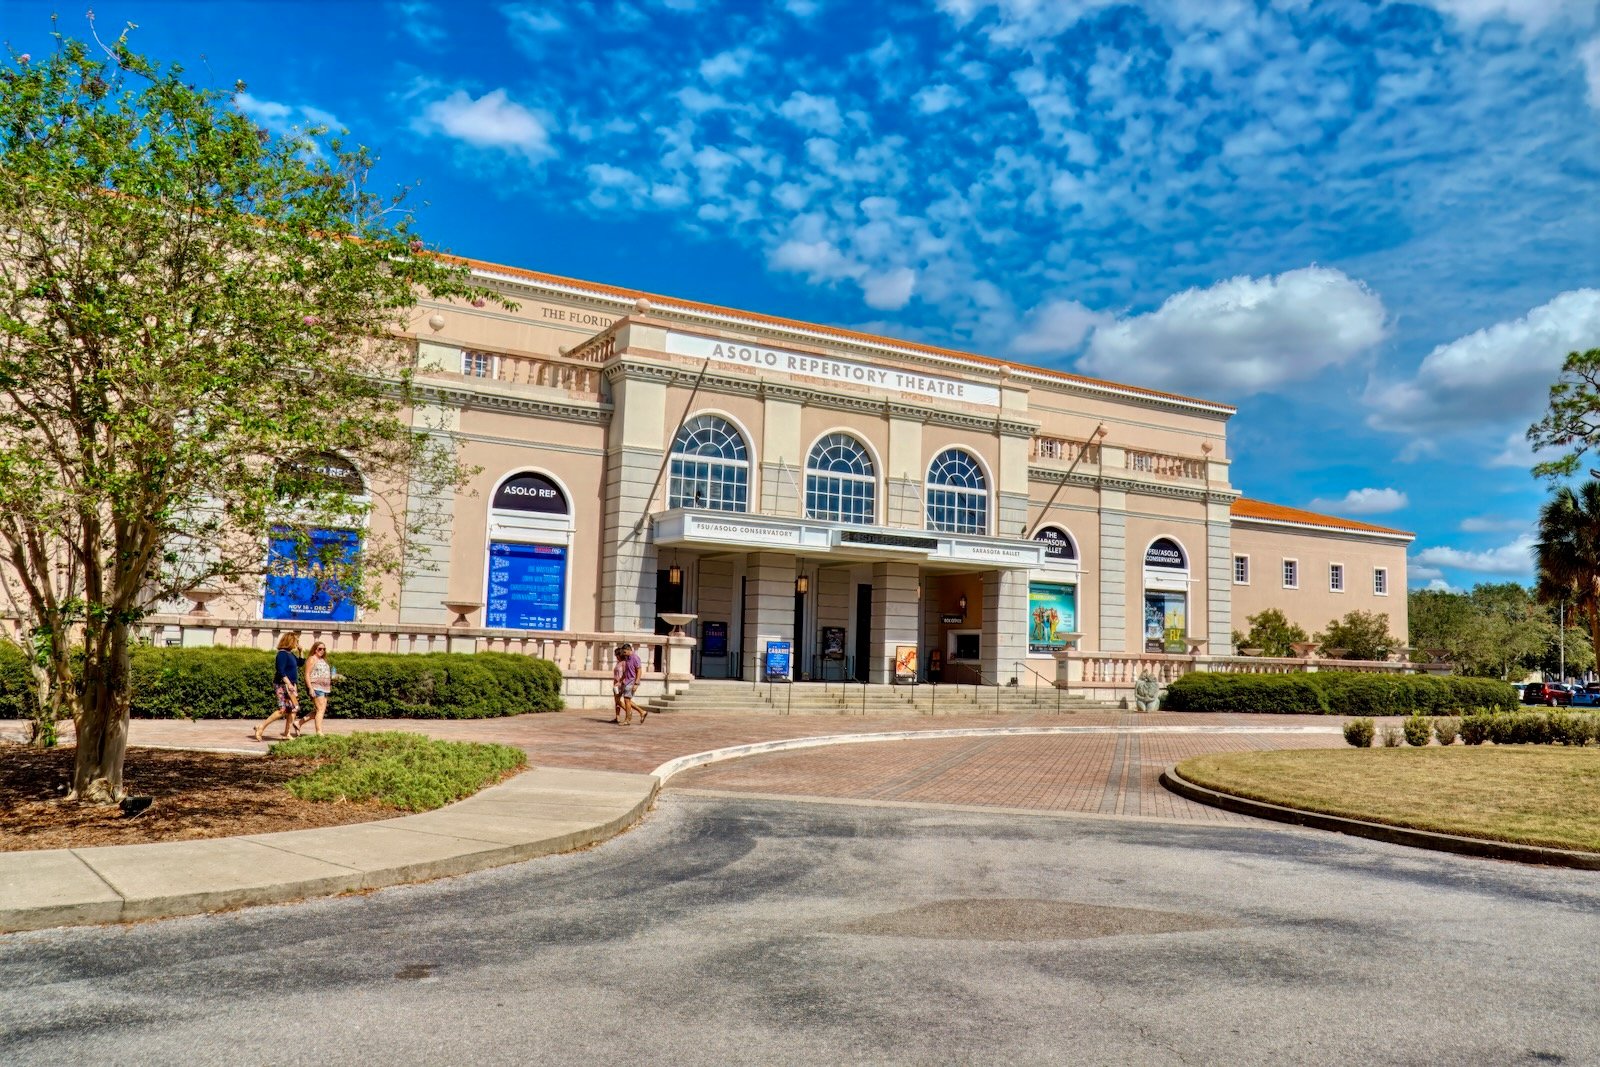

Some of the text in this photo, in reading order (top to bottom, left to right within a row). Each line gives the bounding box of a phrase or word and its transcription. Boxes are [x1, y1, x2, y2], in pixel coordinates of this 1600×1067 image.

[541, 307, 616, 328] THE FLORID
[712, 343, 964, 397] ASOLO REPERTORY THEATRE
[504, 486, 557, 498] ASOLO REP
[697, 523, 794, 537] FSU/ASOLO CONSERVATORY
[1046, 531, 1058, 539] THE
[1046, 546, 1062, 554] ALLET
[1148, 548, 1179, 558] FSU/ASOLO
[1145, 556, 1182, 564] CONSERVATORY
[1170, 629, 1181, 641] FLY
